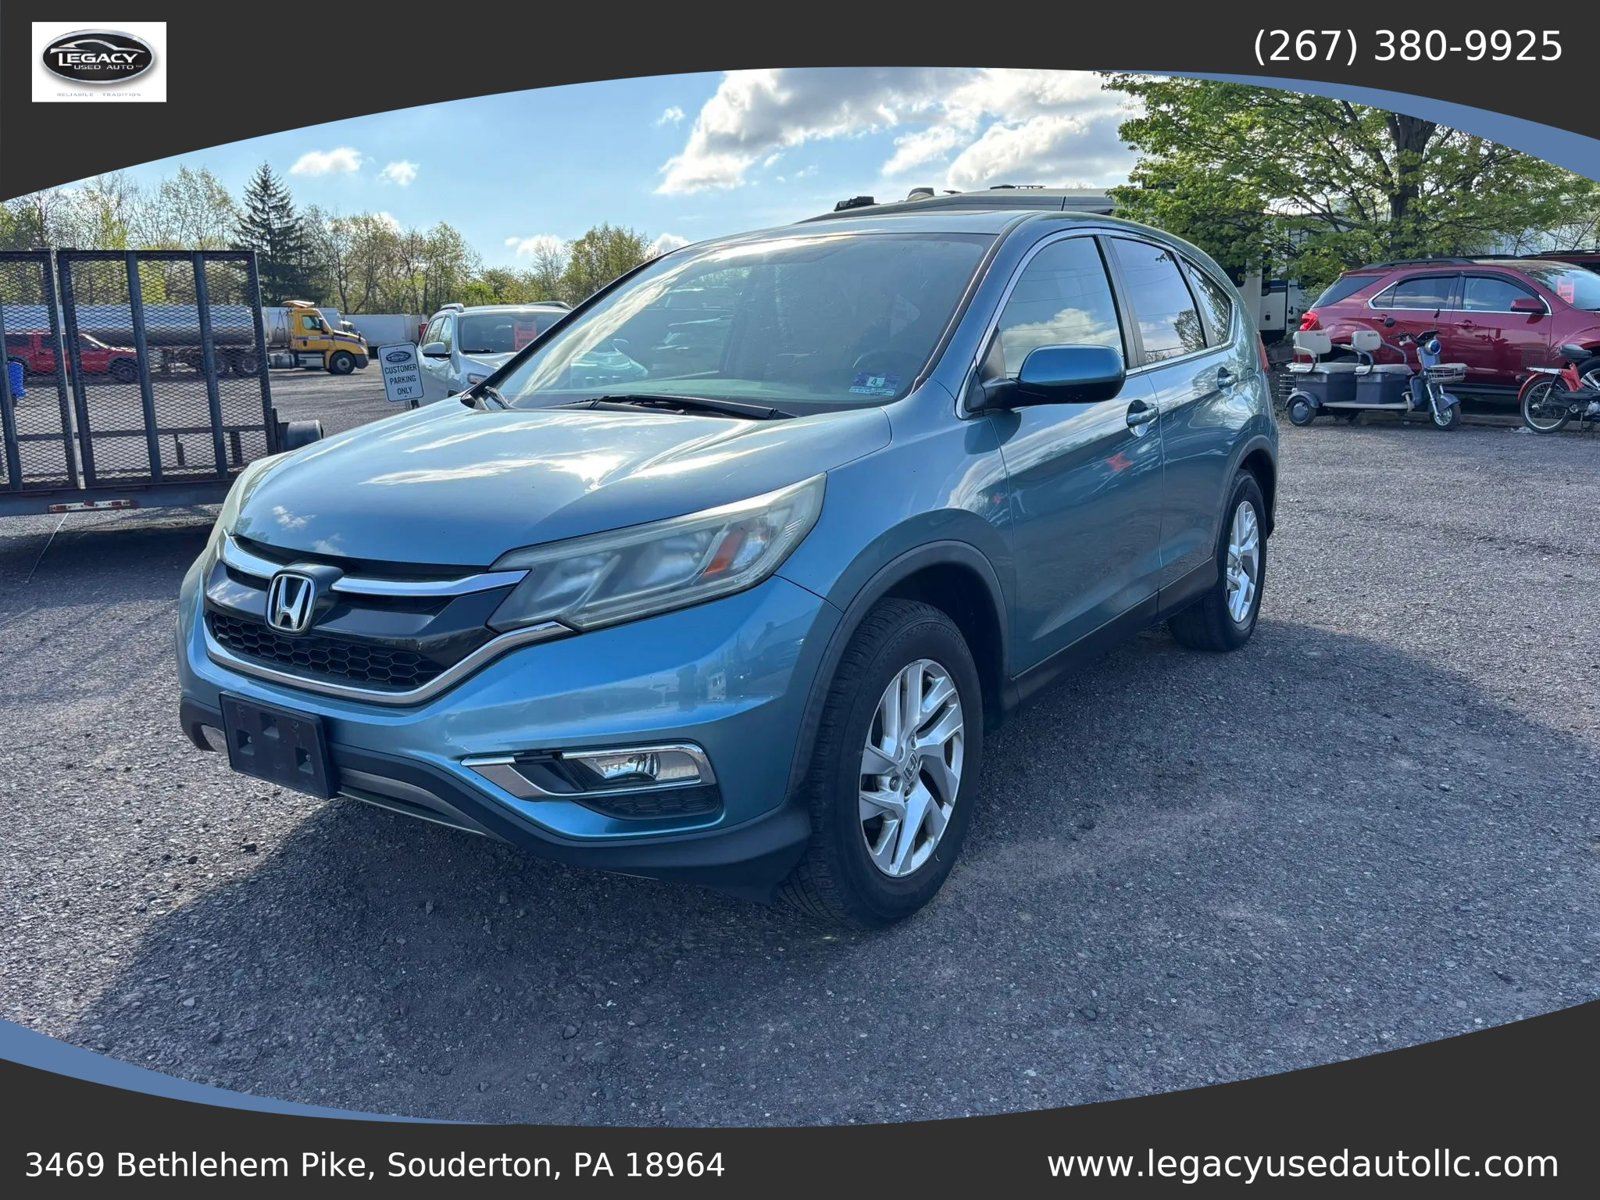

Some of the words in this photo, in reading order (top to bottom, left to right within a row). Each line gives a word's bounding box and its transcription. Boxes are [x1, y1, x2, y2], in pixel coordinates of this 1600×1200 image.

[384, 363, 417, 374] CUSTOMER
[390, 375, 416, 385] PARKING
[397, 386, 413, 395] ONLY
